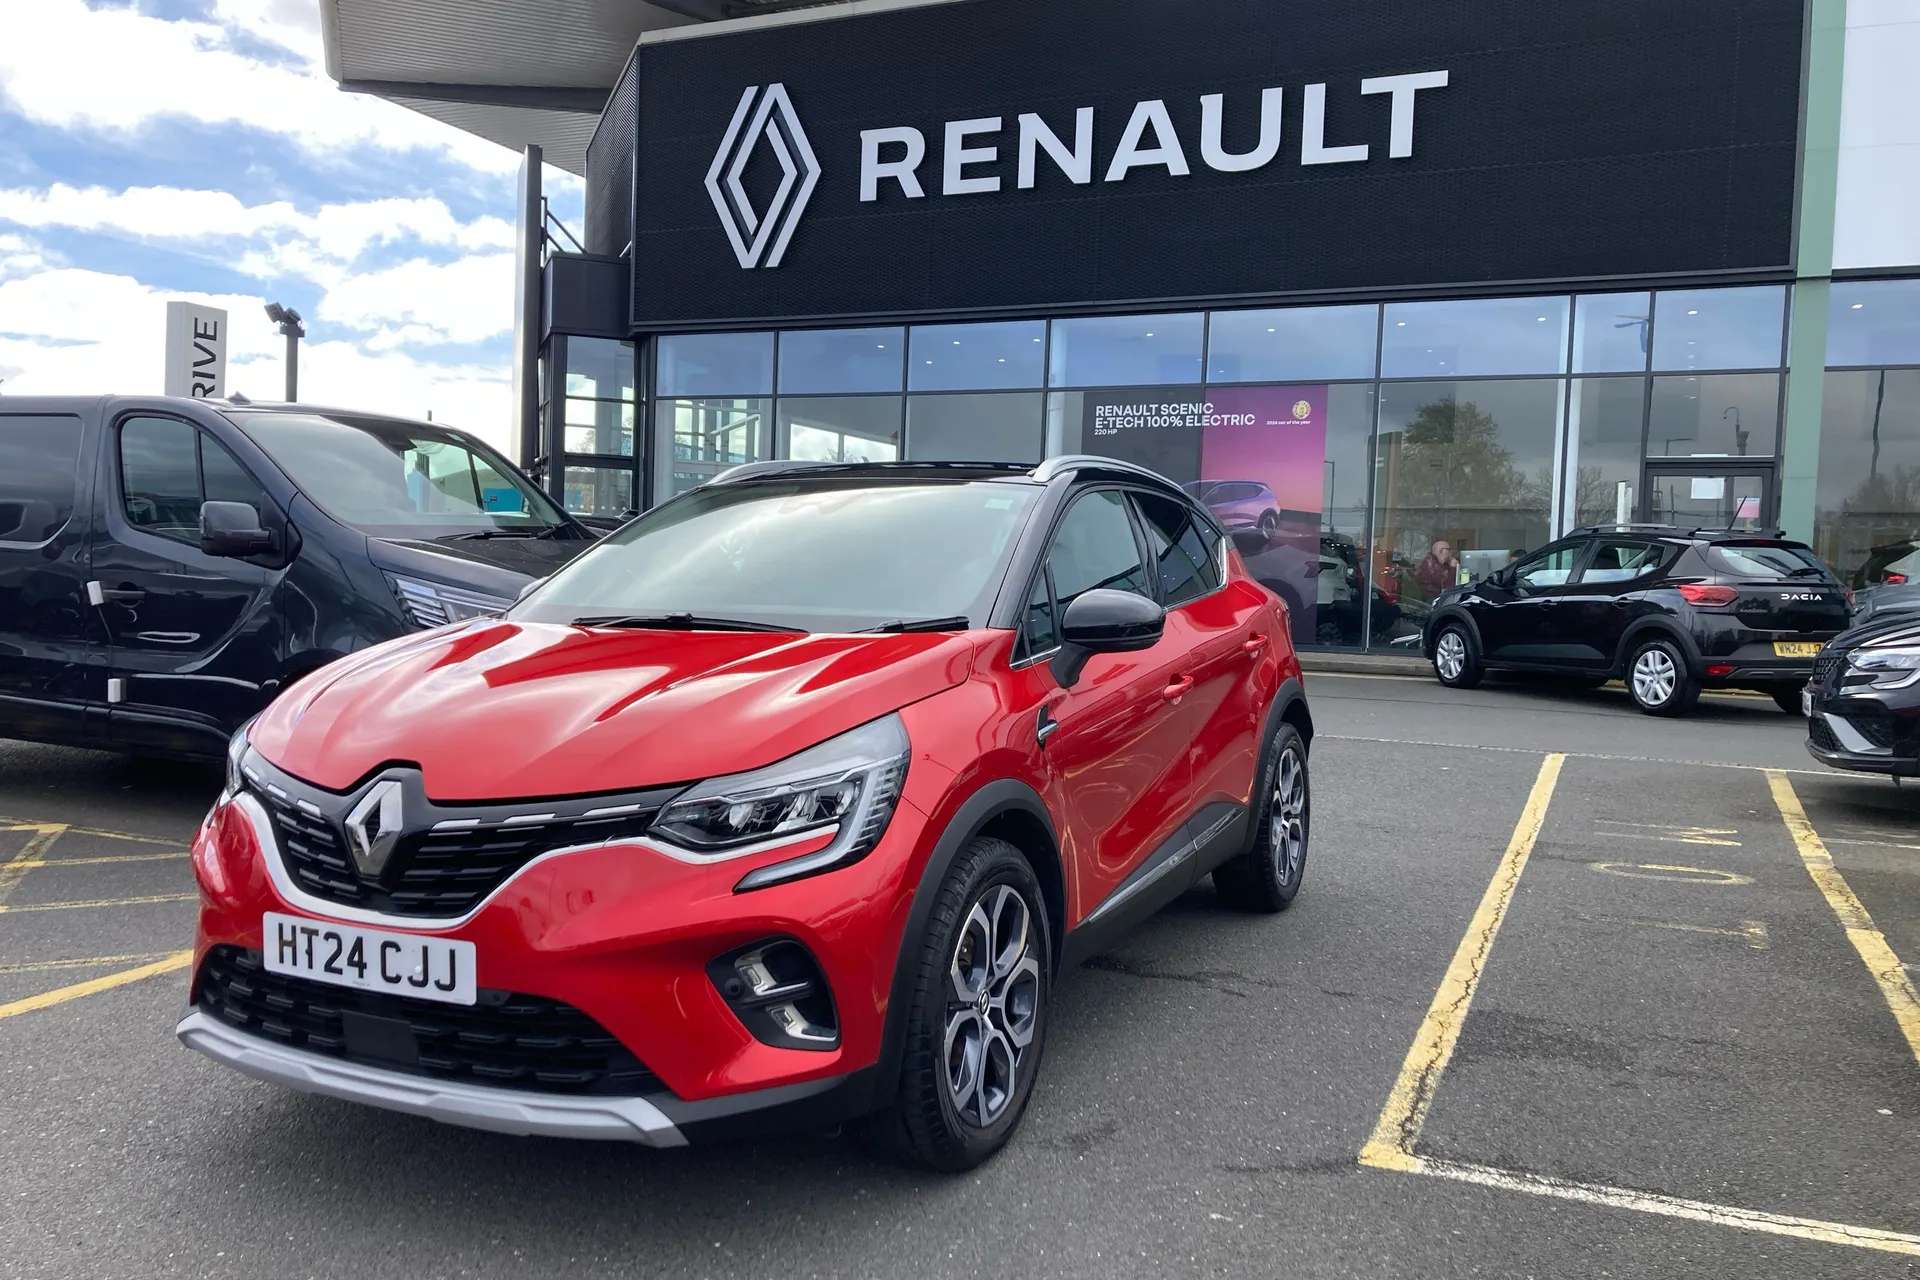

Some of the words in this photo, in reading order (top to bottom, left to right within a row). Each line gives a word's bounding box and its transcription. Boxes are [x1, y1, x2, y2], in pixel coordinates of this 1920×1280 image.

[859, 69, 1449, 202] RENAULT
[1094, 415, 1144, 429] E-TECH
[1146, 414, 1183, 428] 100%
[1186, 413, 1256, 427] ELECTRIC
[1095, 403, 1158, 417] RENAULT
[1160, 402, 1214, 416] SCENIC
[277, 922, 368, 979] HT24
[380, 940, 456, 992] CJJ
